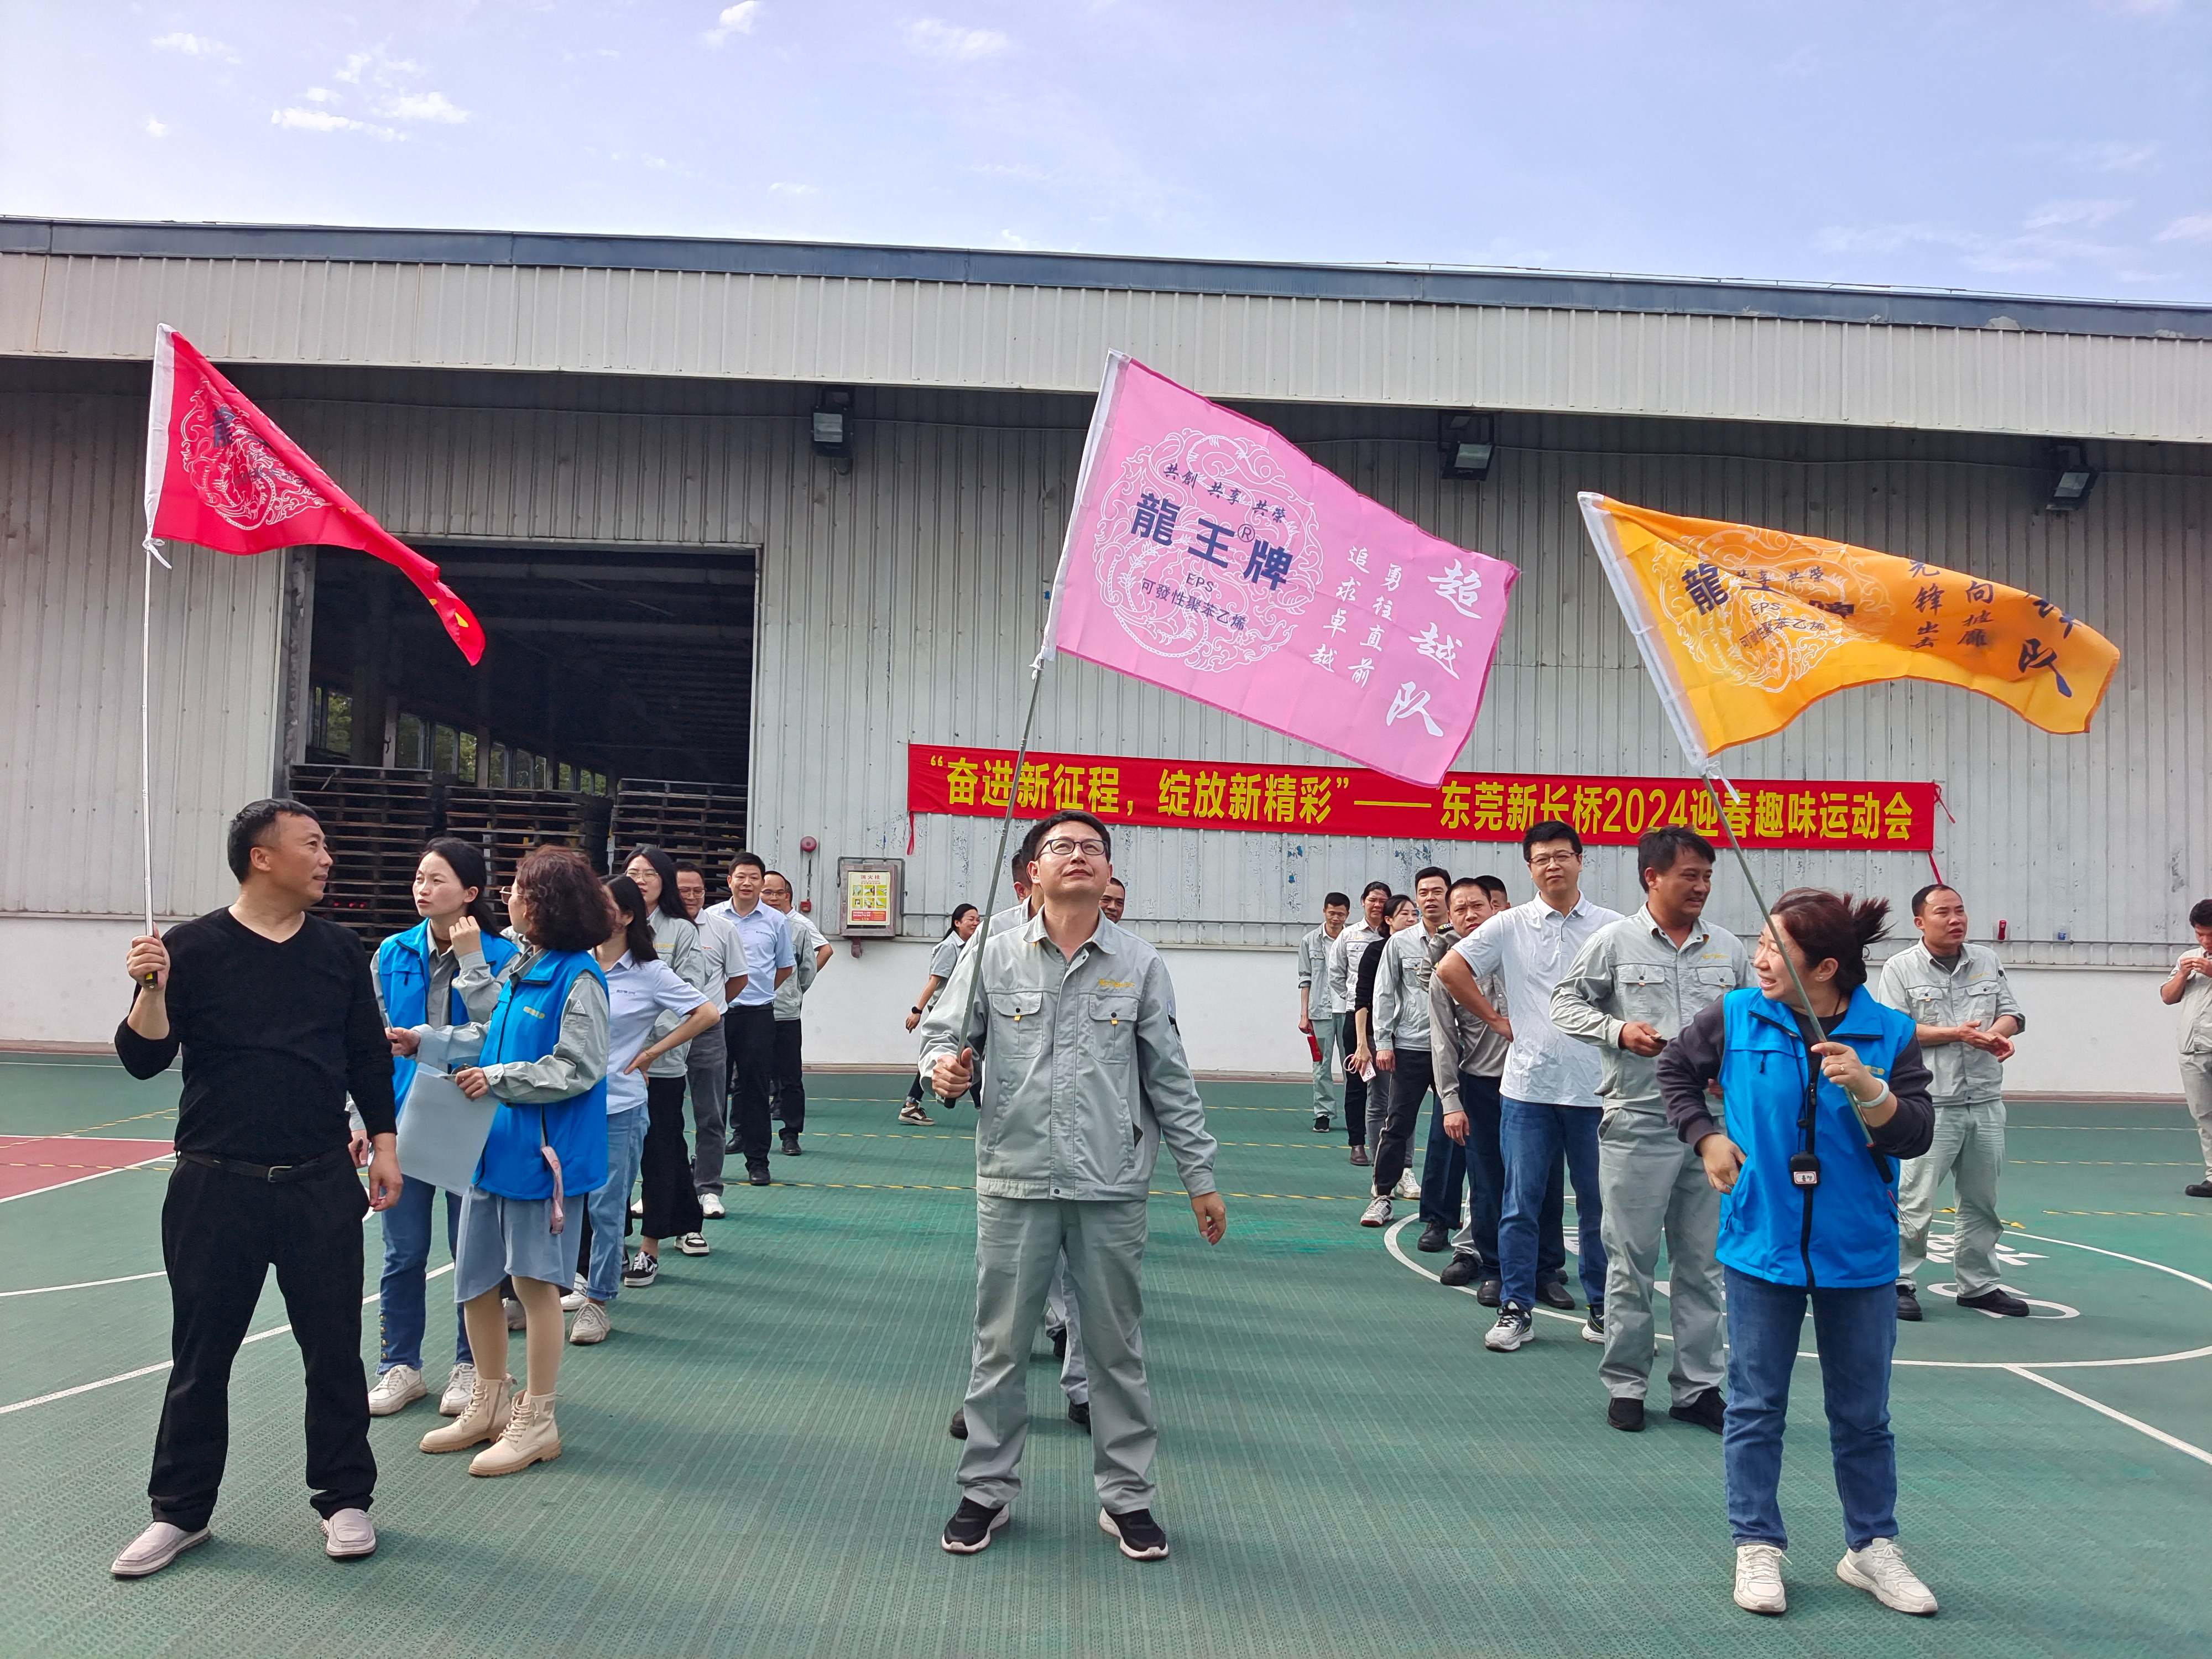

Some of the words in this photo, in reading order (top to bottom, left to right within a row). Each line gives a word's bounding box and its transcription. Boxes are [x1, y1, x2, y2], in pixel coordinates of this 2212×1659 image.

[1164, 463, 1198, 489] 共創
[1208, 482, 1242, 505] 共享
[1142, 578, 1246, 630] 可發性聚苯乙烯
[1186, 573, 1214, 593] EPS
[1308, 545, 1370, 673] 追求卓越
[1751, 602, 1781, 616] EPS
[1347, 562, 1402, 688] 勇往直前
[1386, 559, 1482, 737] 超越队
